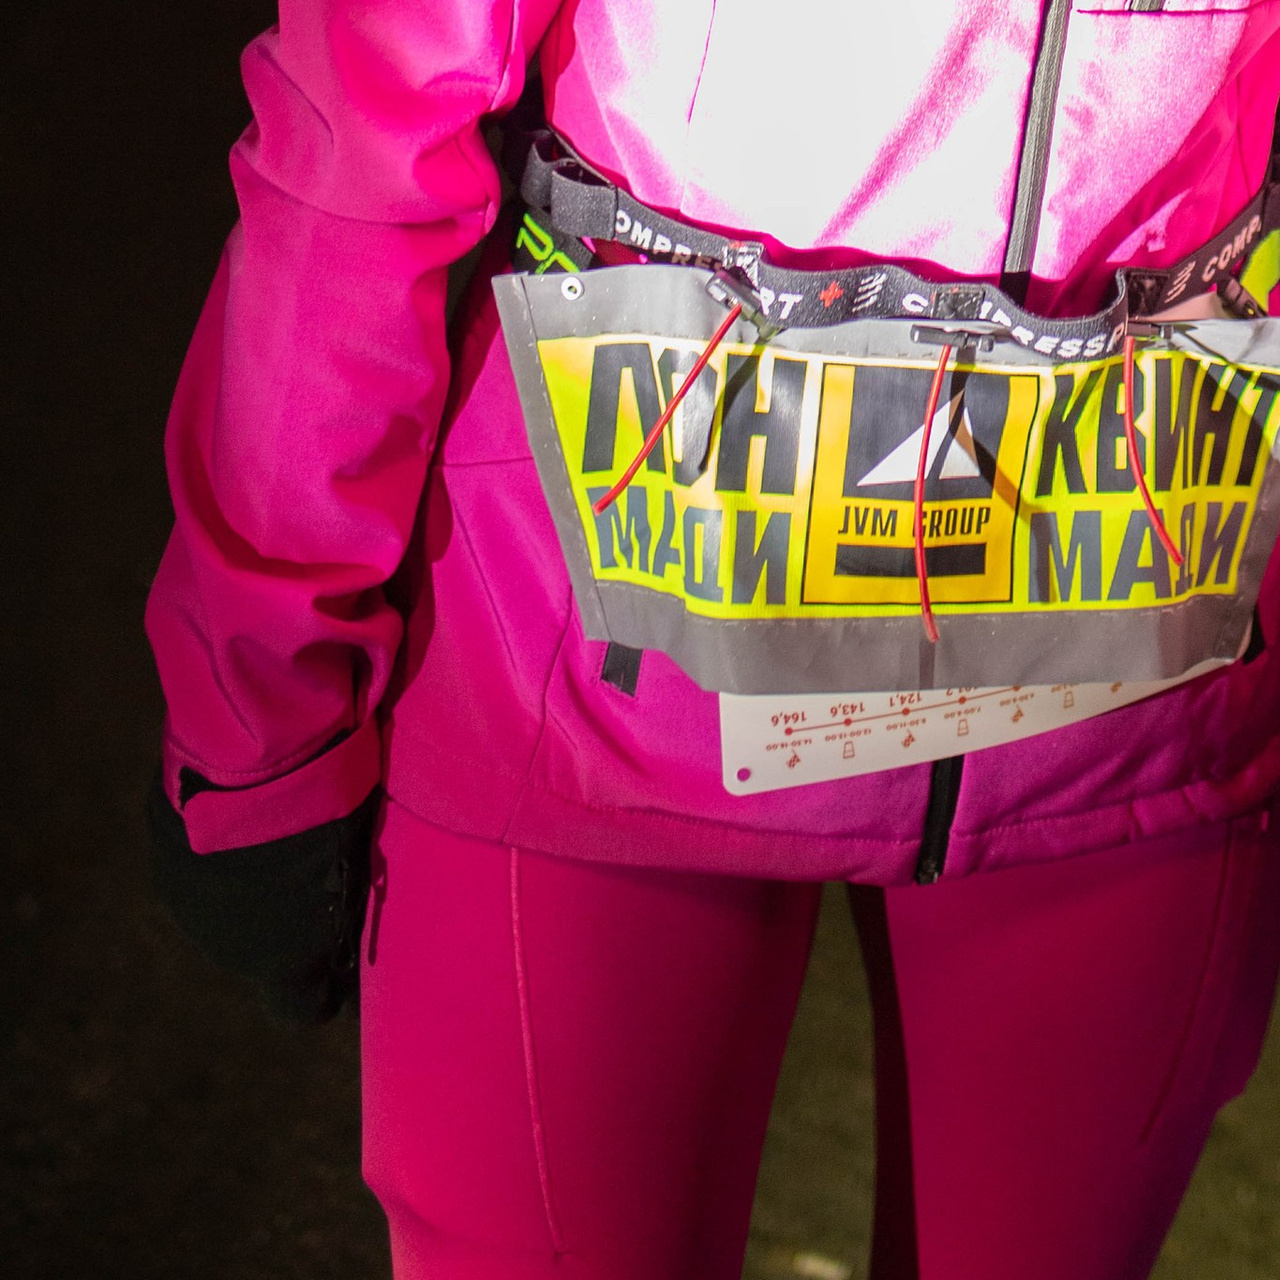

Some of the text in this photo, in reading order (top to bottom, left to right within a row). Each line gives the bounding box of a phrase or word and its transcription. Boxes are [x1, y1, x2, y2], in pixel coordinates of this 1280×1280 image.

[582, 343, 808, 496] ЛОН
[838, 505, 991, 539] JVM GROUP
[586, 485, 1249, 606] МАДИ МАДИ
[830, 702, 866, 718] 143,6
[888, 692, 923, 708] 124,1
[771, 711, 807, 727] 164,6
